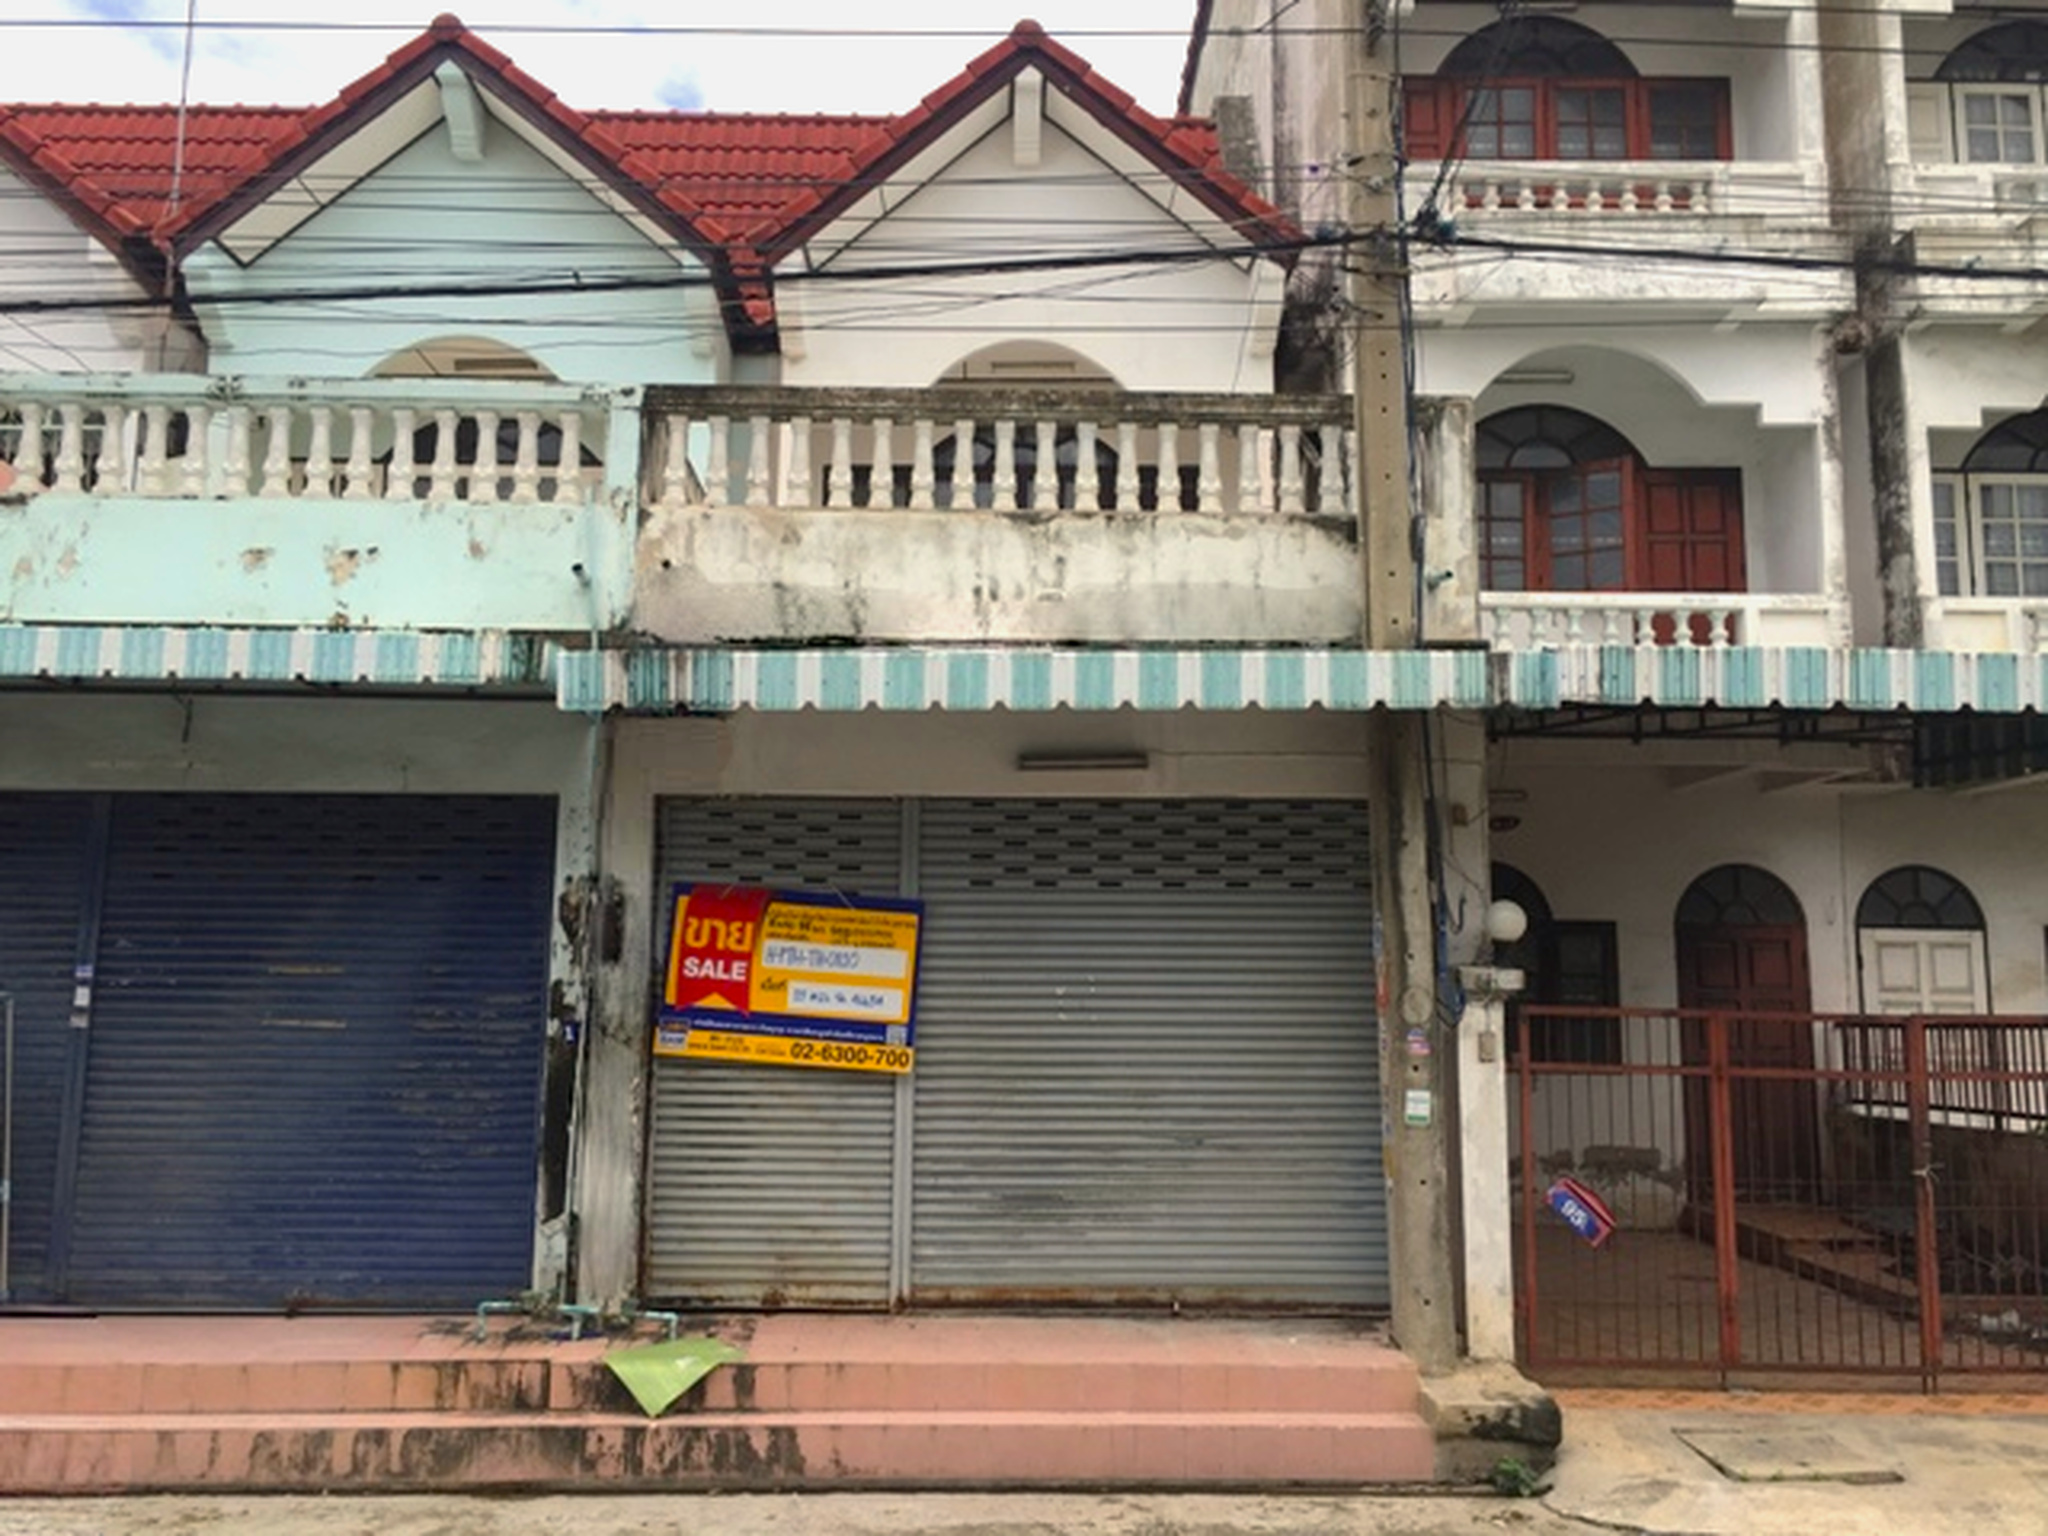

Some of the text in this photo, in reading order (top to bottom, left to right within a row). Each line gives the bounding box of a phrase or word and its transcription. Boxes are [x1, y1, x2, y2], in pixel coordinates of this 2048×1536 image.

[684, 917, 754, 953] ขาย
[683, 955, 748, 981] SALE
[790, 1042, 910, 1068] 02-6300-700
